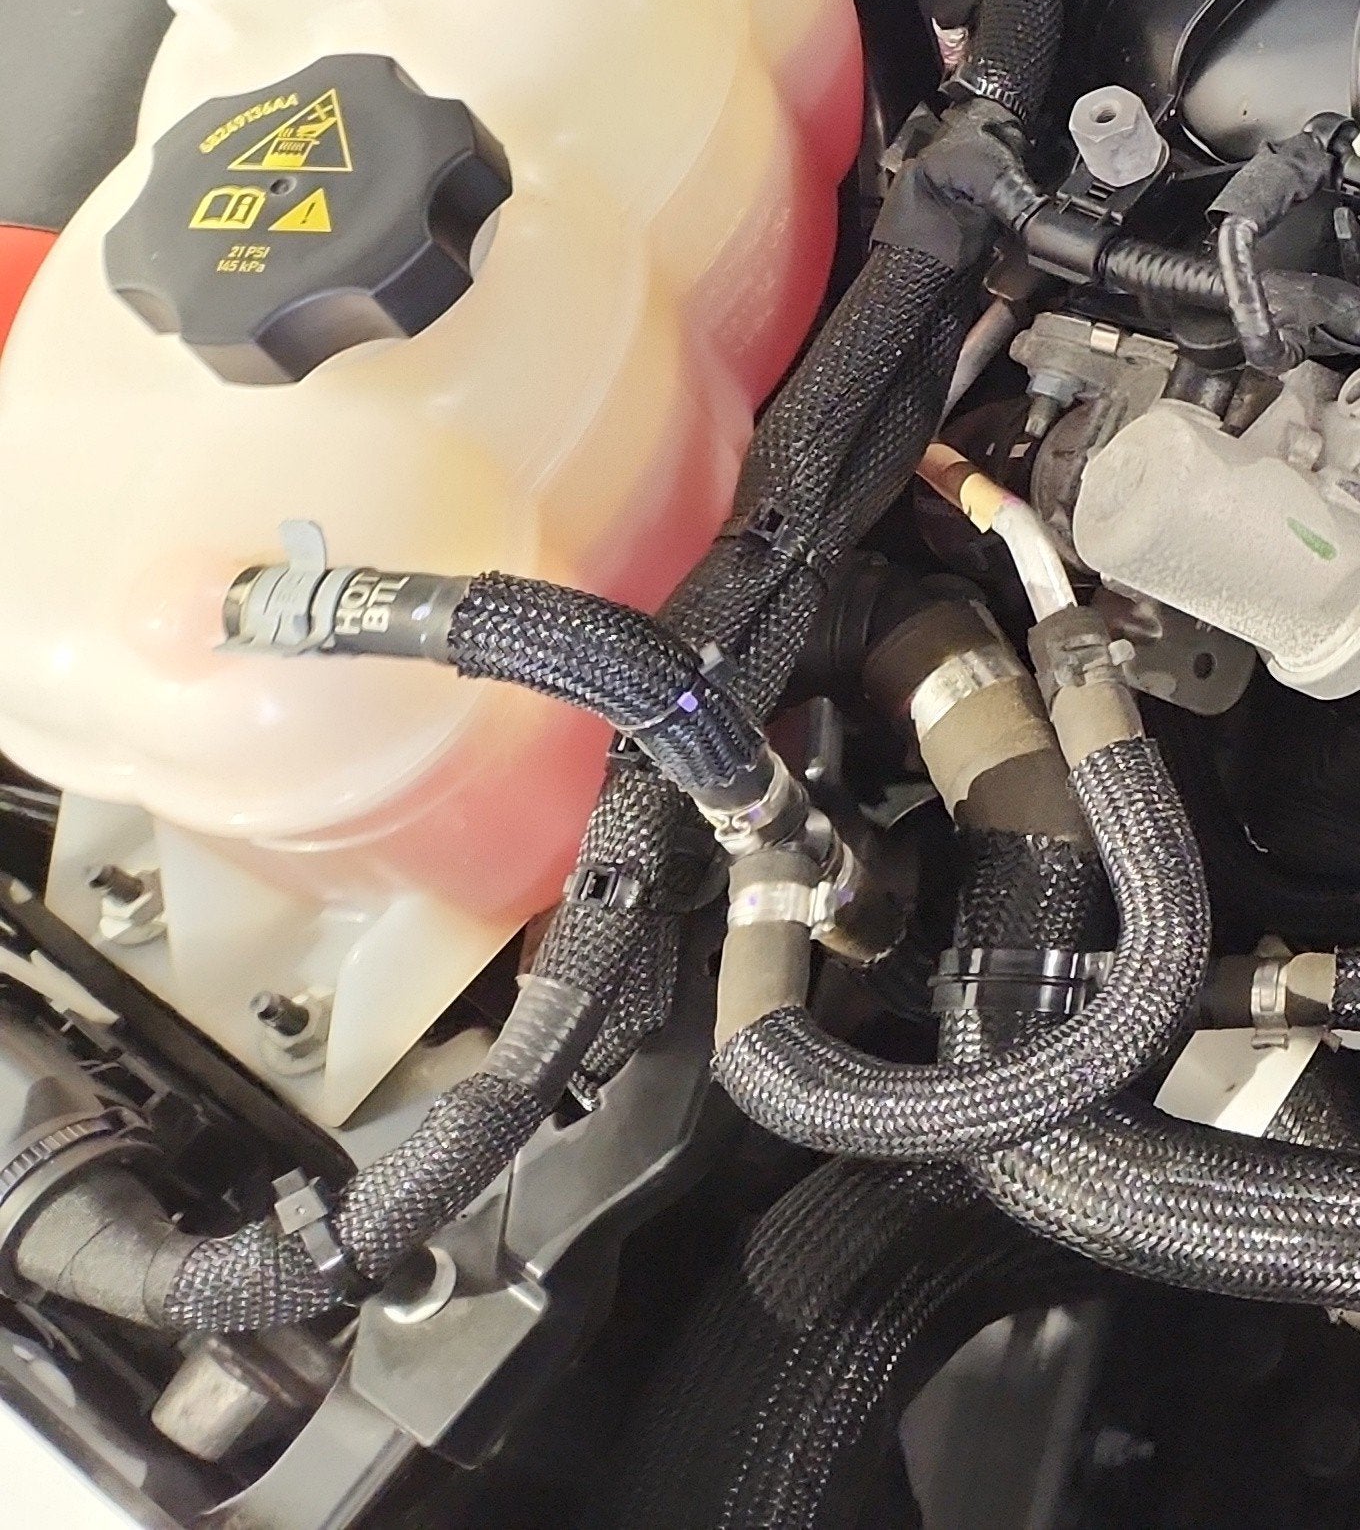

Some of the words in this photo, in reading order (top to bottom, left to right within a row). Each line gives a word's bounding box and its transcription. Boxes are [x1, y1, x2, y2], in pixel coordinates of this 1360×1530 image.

[217, 259, 238, 272] 145
[239, 260, 266, 273] kPa
[228, 245, 244, 259] 21
[246, 245, 271, 259] PSI
[335, 571, 381, 635] HOT
[361, 576, 410, 633] BTL
